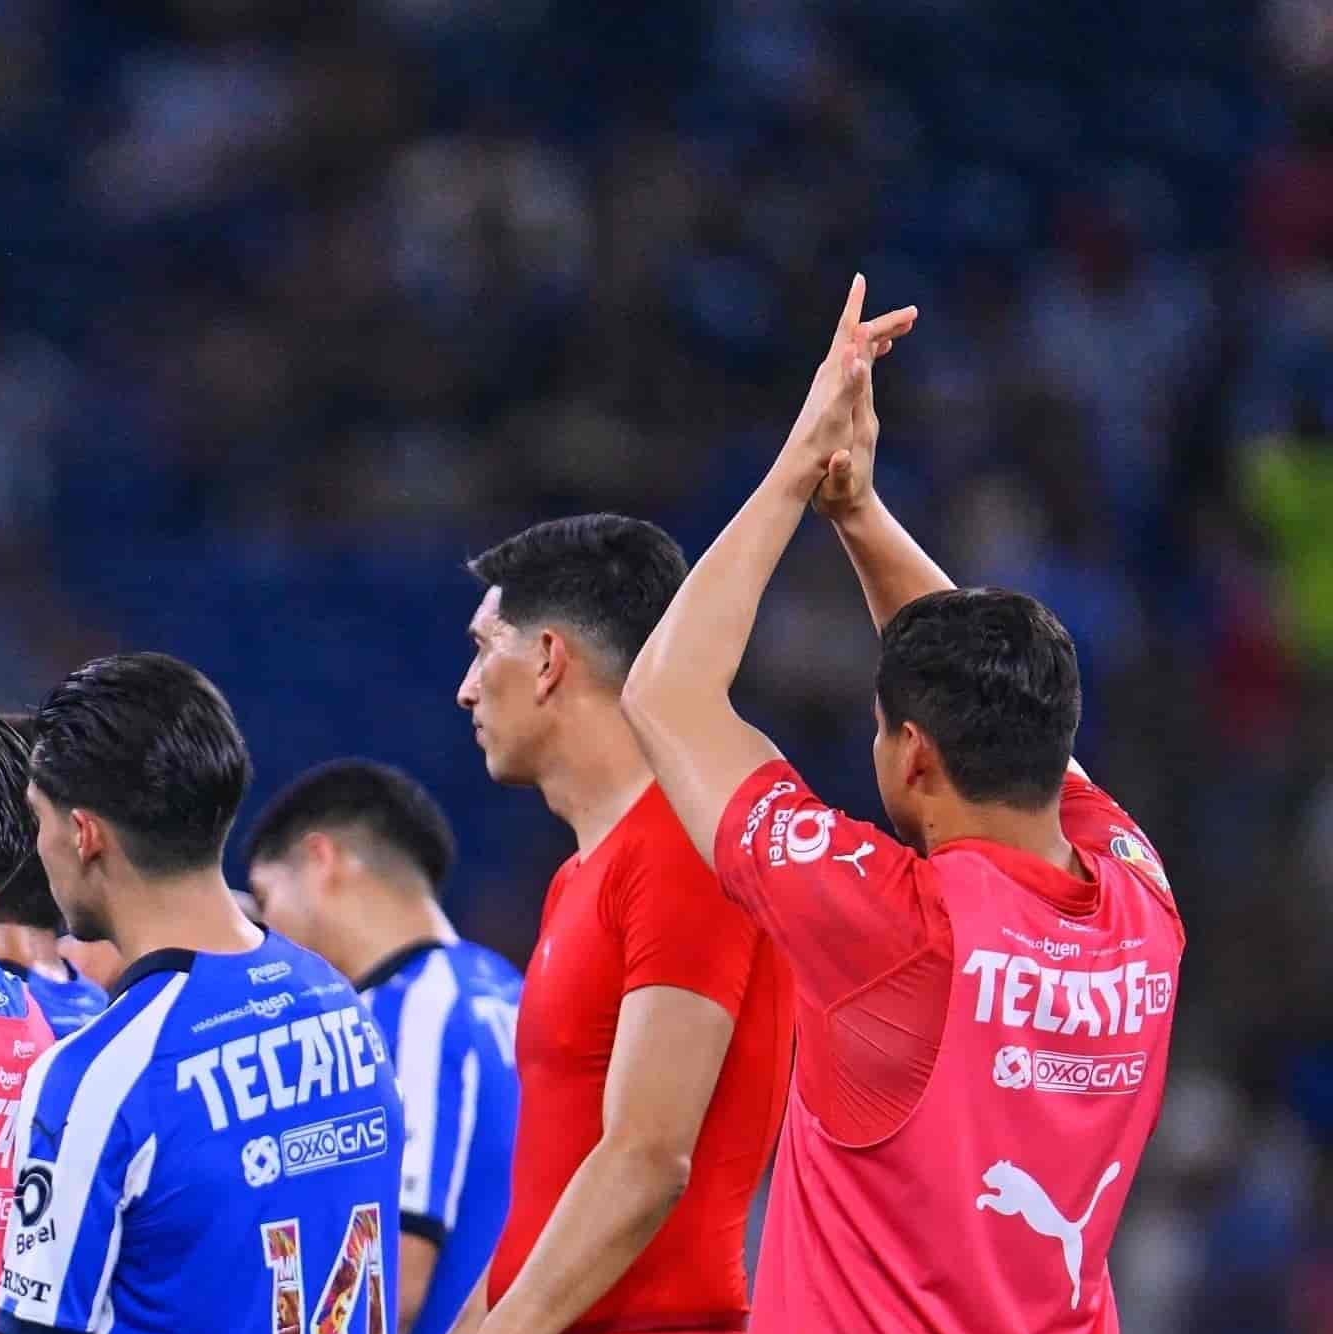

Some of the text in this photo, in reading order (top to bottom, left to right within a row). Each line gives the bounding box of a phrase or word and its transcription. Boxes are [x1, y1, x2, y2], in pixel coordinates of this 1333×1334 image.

[768, 807, 796, 867] Berel
[962, 949, 1148, 1036] TECATE
[177, 1005, 377, 1131] TECATE
[15, 1218, 56, 1256] Beel
